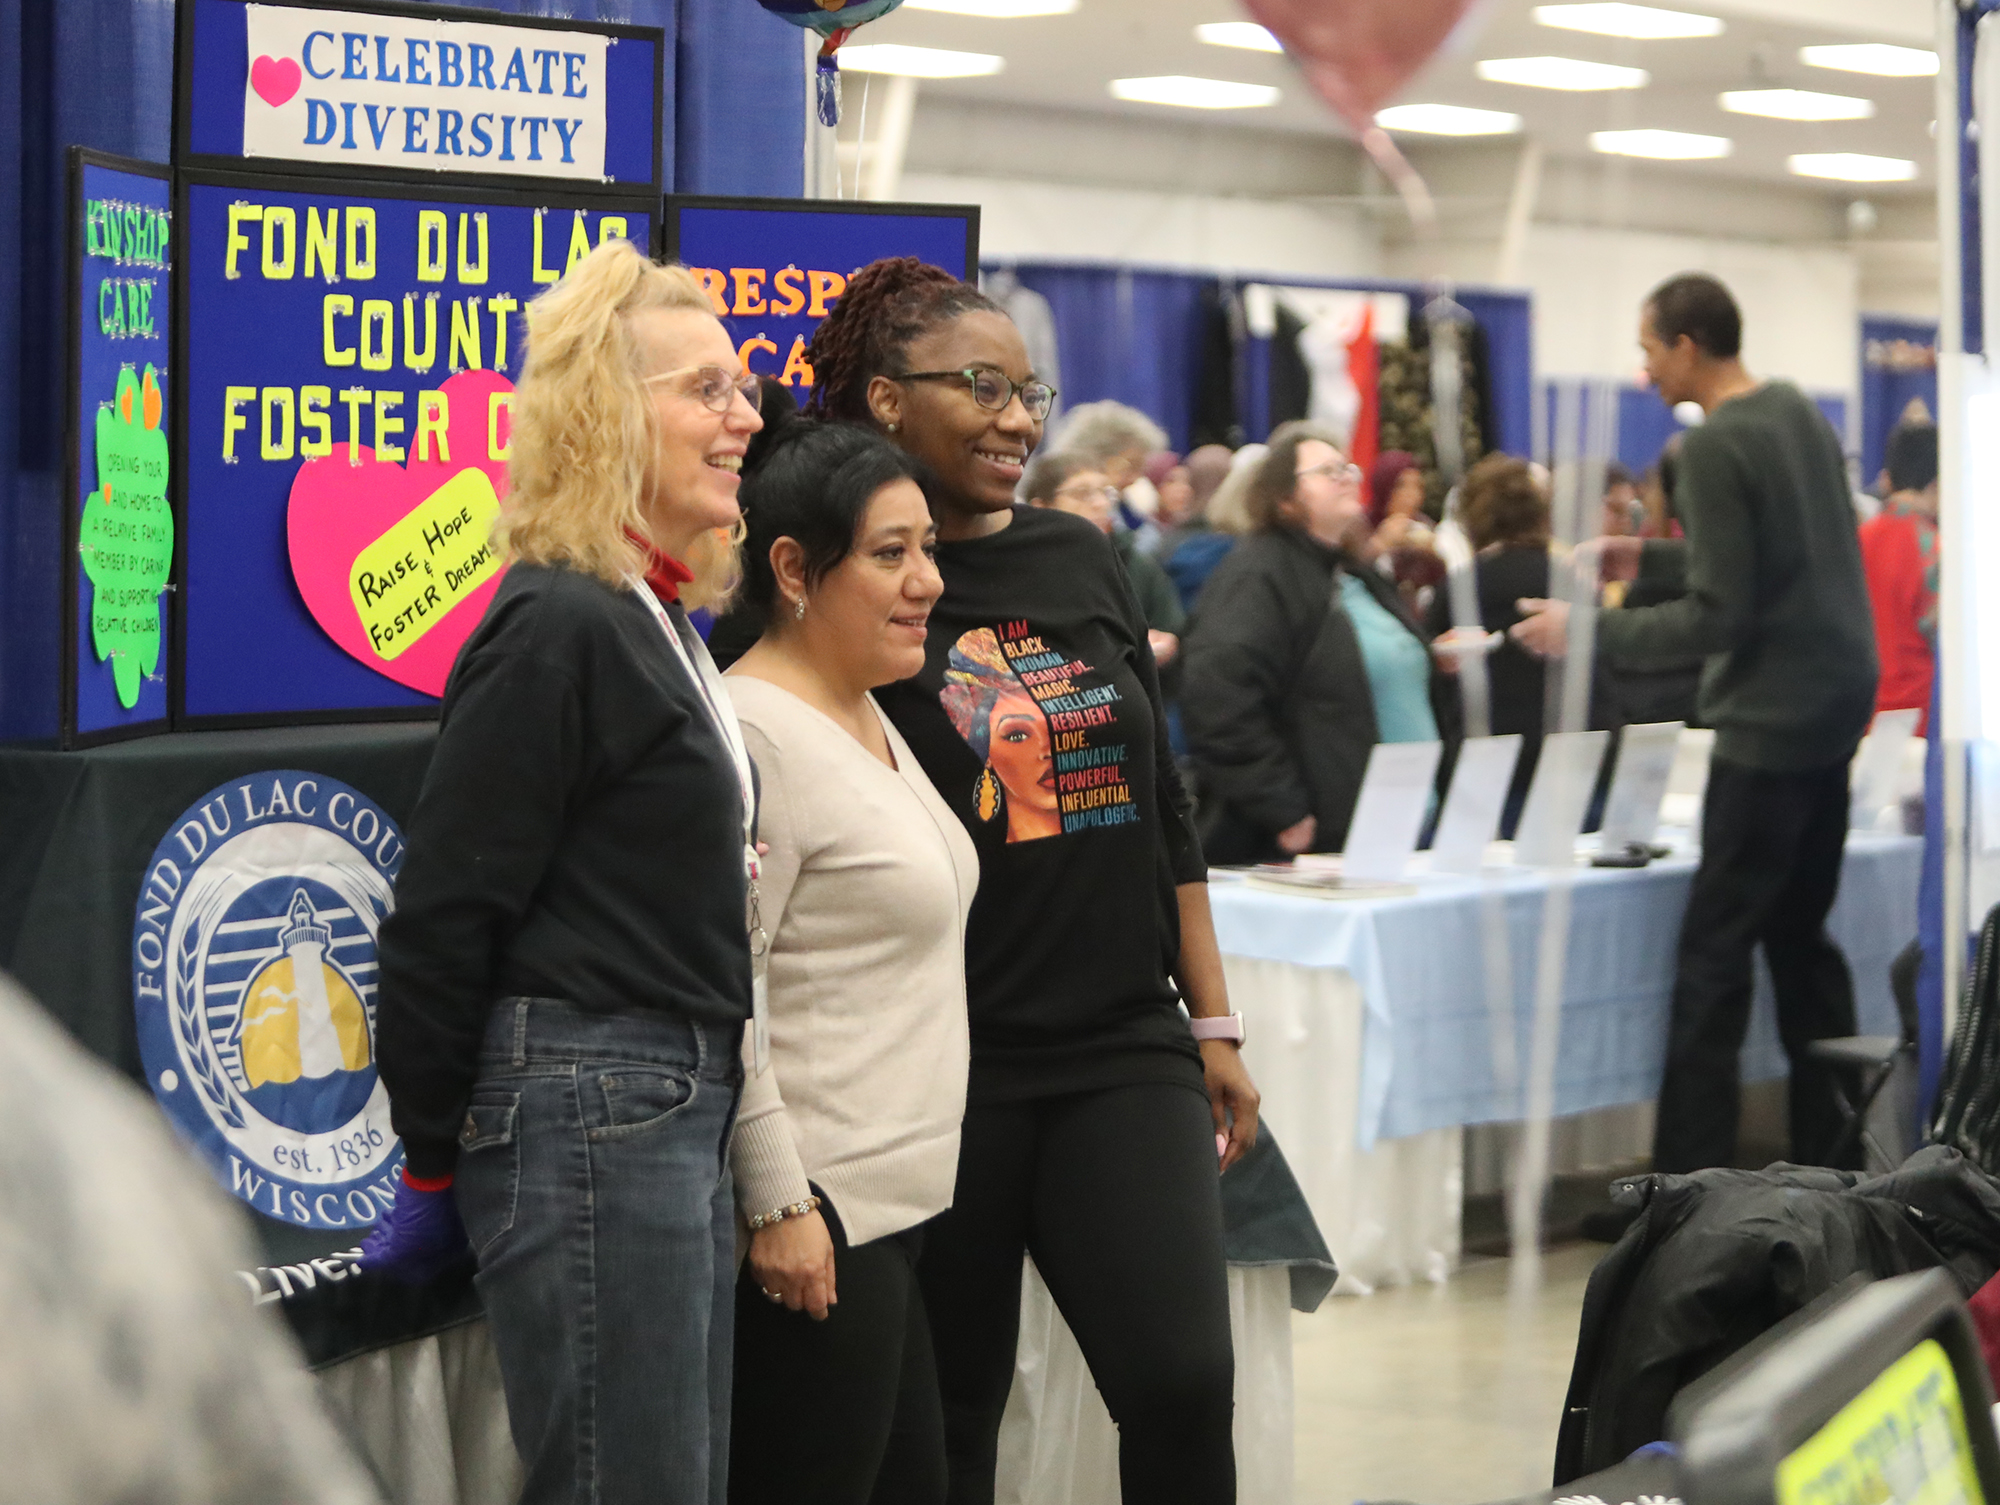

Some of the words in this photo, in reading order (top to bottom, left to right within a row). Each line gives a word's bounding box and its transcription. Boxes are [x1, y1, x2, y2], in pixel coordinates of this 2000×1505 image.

[302, 30, 588, 98] CELEBRATE
[303, 97, 583, 164] DIVERSITY
[87, 200, 169, 263] KINSHIP
[226, 204, 377, 280] FOND
[417, 210, 488, 284] DU
[100, 279, 154, 334] CARE
[690, 267, 856, 317] RESP
[323, 294, 536, 371] COUNT
[223, 385, 451, 461] FOSTER
[358, 551, 419, 608] RAISE
[422, 506, 472, 556] HOPE
[370, 584, 442, 651] FOSTER
[445, 543, 492, 591] DREAM
[998, 623, 1005, 640] I
[1008, 618, 1029, 639] AM
[1003, 636, 1050, 659] BLACK.
[1011, 652, 1069, 673] WOMAN.
[1030, 679, 1080, 700] MAGIC.
[1040, 683, 1122, 713] INTELLIGENT.
[1050, 704, 1117, 732] RESILIENT.
[1054, 730, 1090, 752] LOVE.
[1057, 744, 1129, 771] INNOVATIVE.
[1059, 765, 1125, 792] POWERFUL.
[138, 858, 182, 1001] FOND
[175, 793, 231, 864] DU
[239, 778, 317, 822] LAC
[328, 792, 405, 882] COU
[273, 1143, 323, 1173] est.
[329, 1118, 384, 1172] 1836
